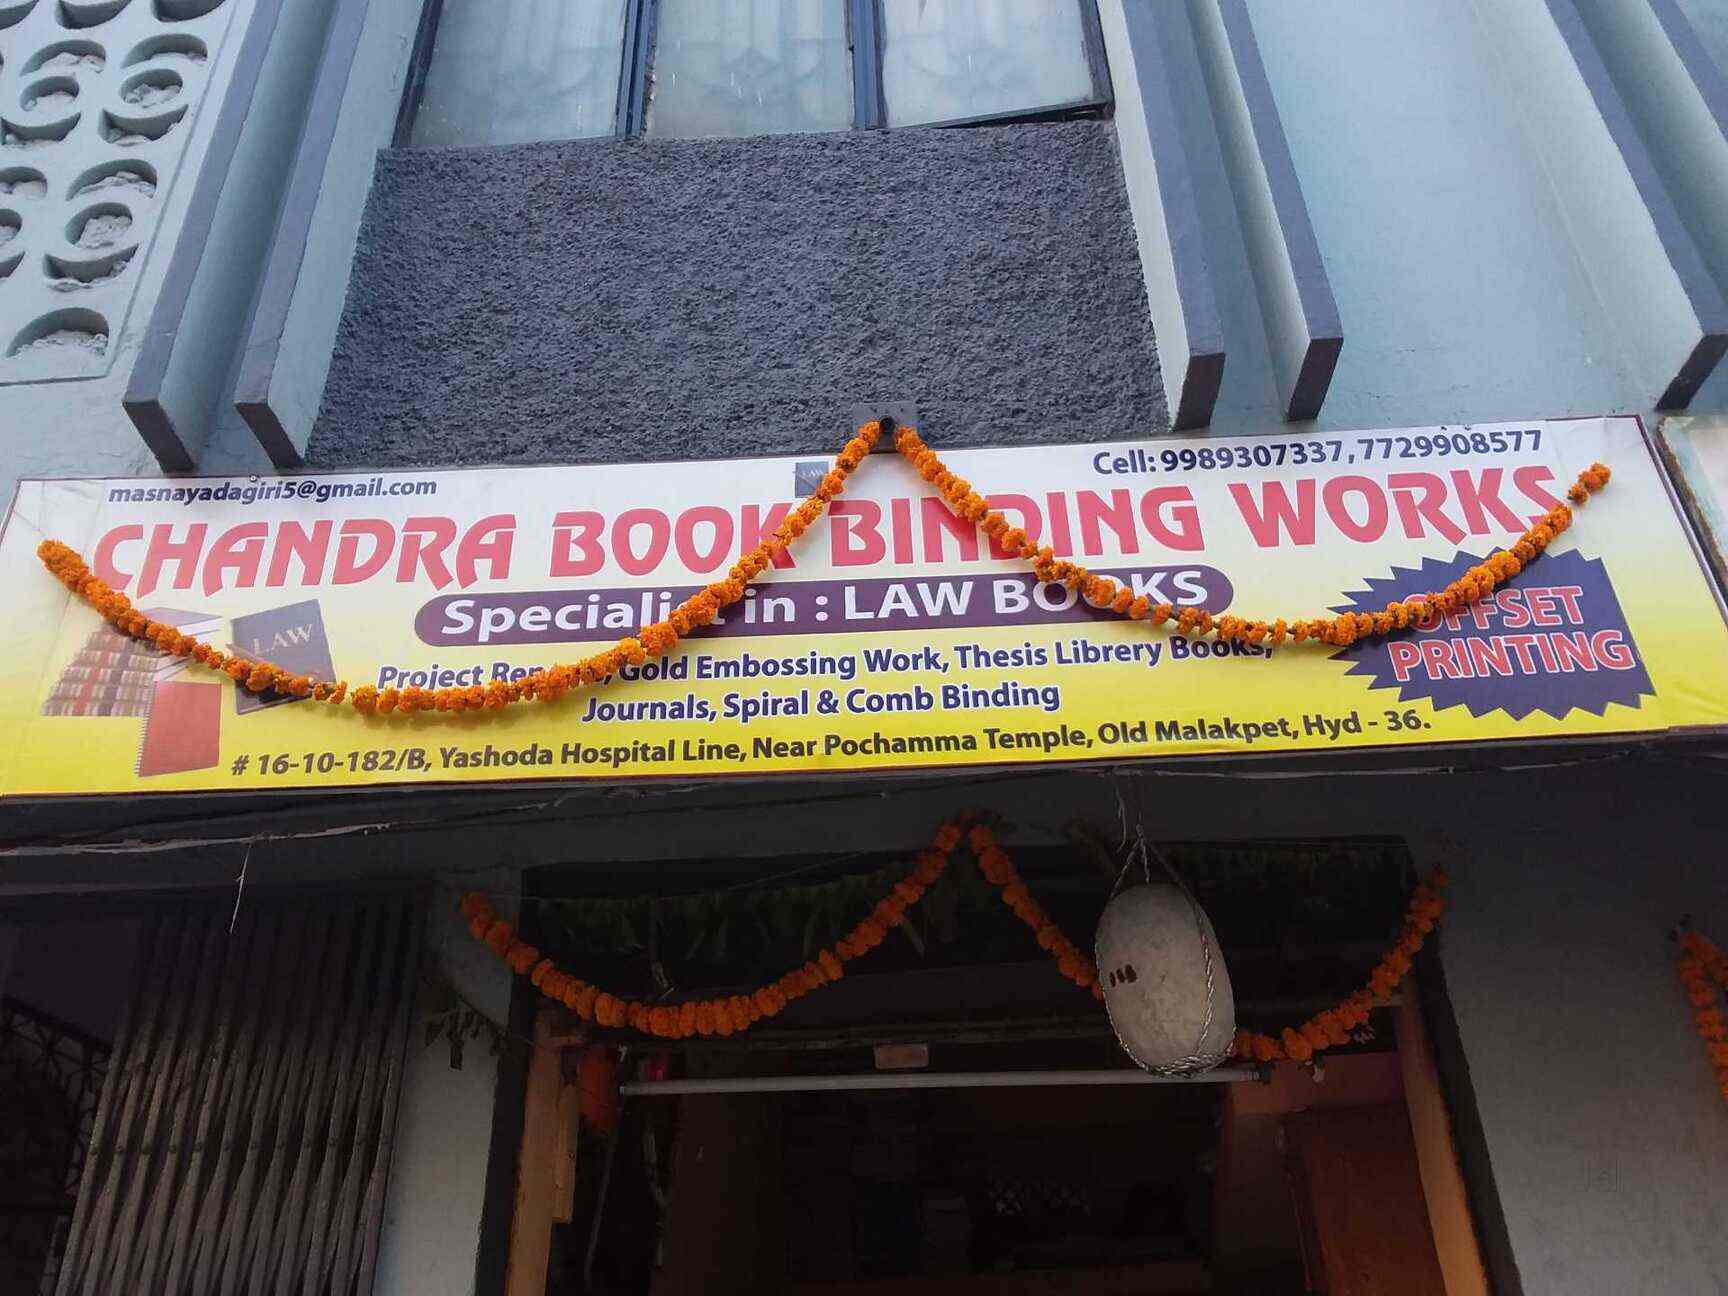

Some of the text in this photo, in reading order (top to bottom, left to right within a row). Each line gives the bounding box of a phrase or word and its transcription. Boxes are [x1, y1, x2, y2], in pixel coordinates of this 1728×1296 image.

[108, 477, 437, 505] masnayadagiri5@gmail.com
[93, 465, 1567, 598] CHANDRA BOOK BINDING WORKS
[441, 592, 725, 642] Speciali
[744, 589, 796, 623] in
[845, 580, 972, 620] LAW
[252, 623, 312, 656] LAW
[377, 664, 484, 691] Project
[619, 658, 688, 682] Gold
[695, 651, 857, 681] Embossing
[863, 644, 949, 676] Work,
[953, 639, 1048, 670] Thesis
[1055, 637, 1162, 667] Librery
[1169, 635, 1274, 661] Books,
[1387, 629, 1637, 682] PRINTING
[582, 680, 1061, 724] Journals, Spiral & Comb Binding
[231, 753, 248, 775] #
[259, 746, 432, 775] 16-10-182/B,
[440, 743, 554, 770] Yashoda
[560, 738, 675, 768] Hospital
[683, 736, 746, 764] Line,
[752, 731, 817, 758] Near
[824, 725, 976, 757] Pochamma
[982, 722, 1093, 755] Temple,
[1098, 717, 1149, 744] Old
[1156, 711, 1299, 746] Malakpet,
[1303, 710, 1360, 741] Hyd
[1387, 709, 1431, 734] 36.
